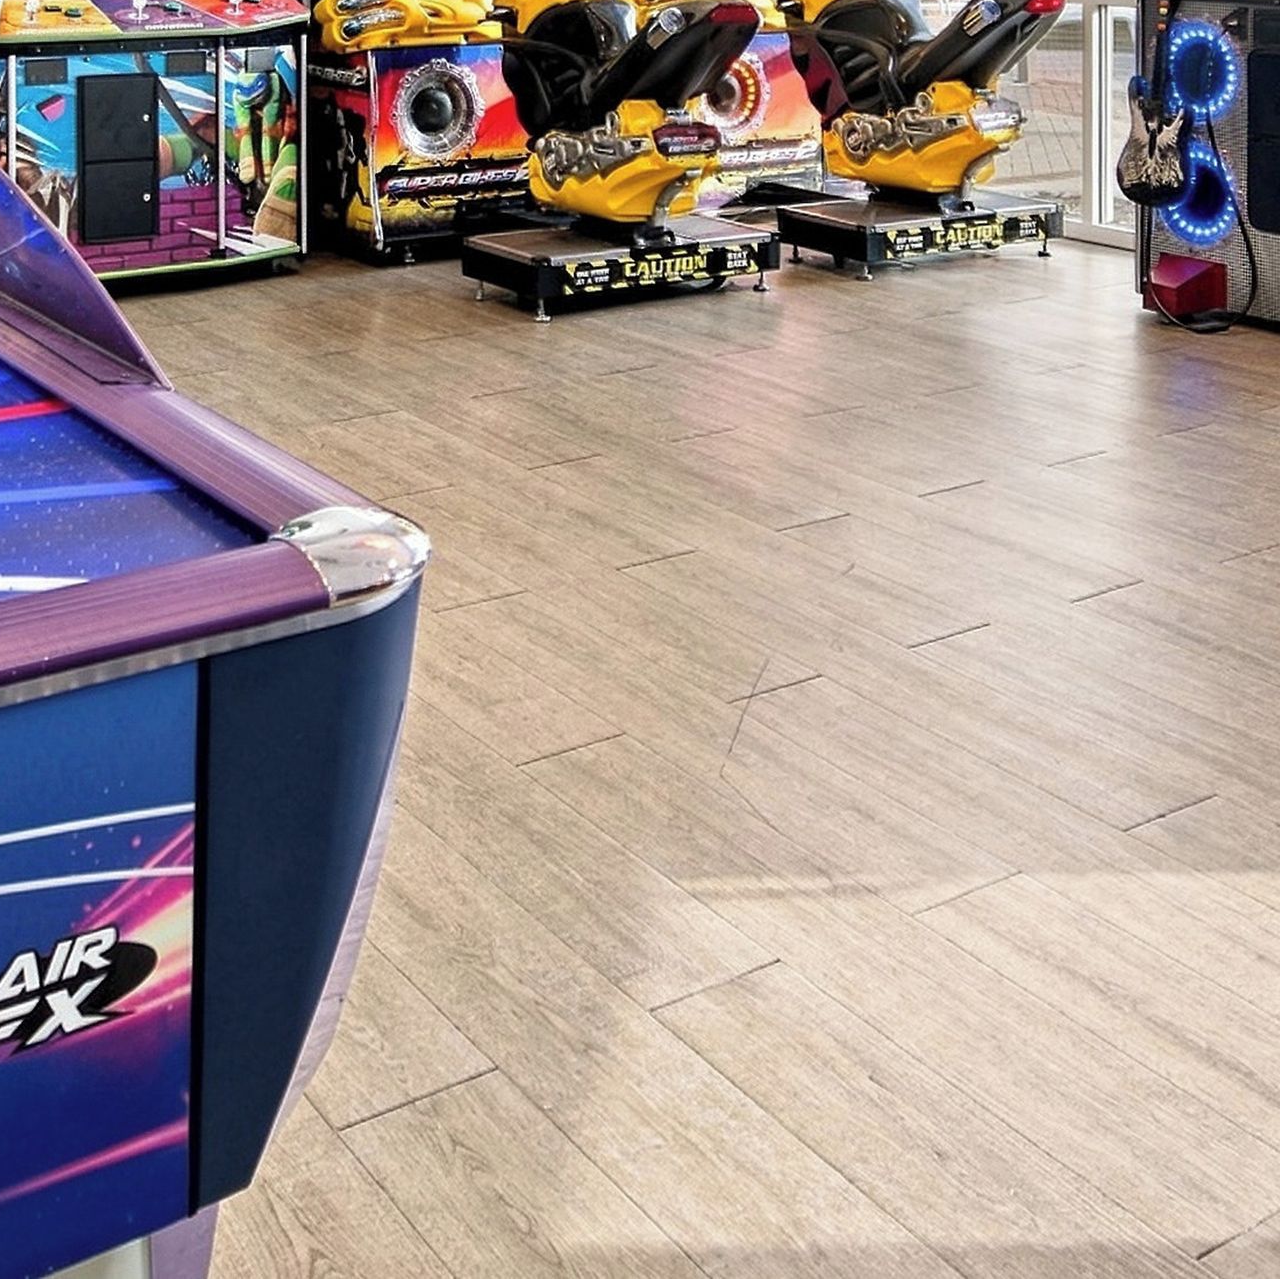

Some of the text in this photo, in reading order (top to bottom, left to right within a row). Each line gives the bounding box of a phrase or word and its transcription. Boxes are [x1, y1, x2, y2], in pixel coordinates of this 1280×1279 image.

[387, 173, 457, 194] SUPER
[457, 168, 519, 187] BIKES
[935, 224, 1005, 244] CAUTION
[625, 255, 708, 278] CAUTION
